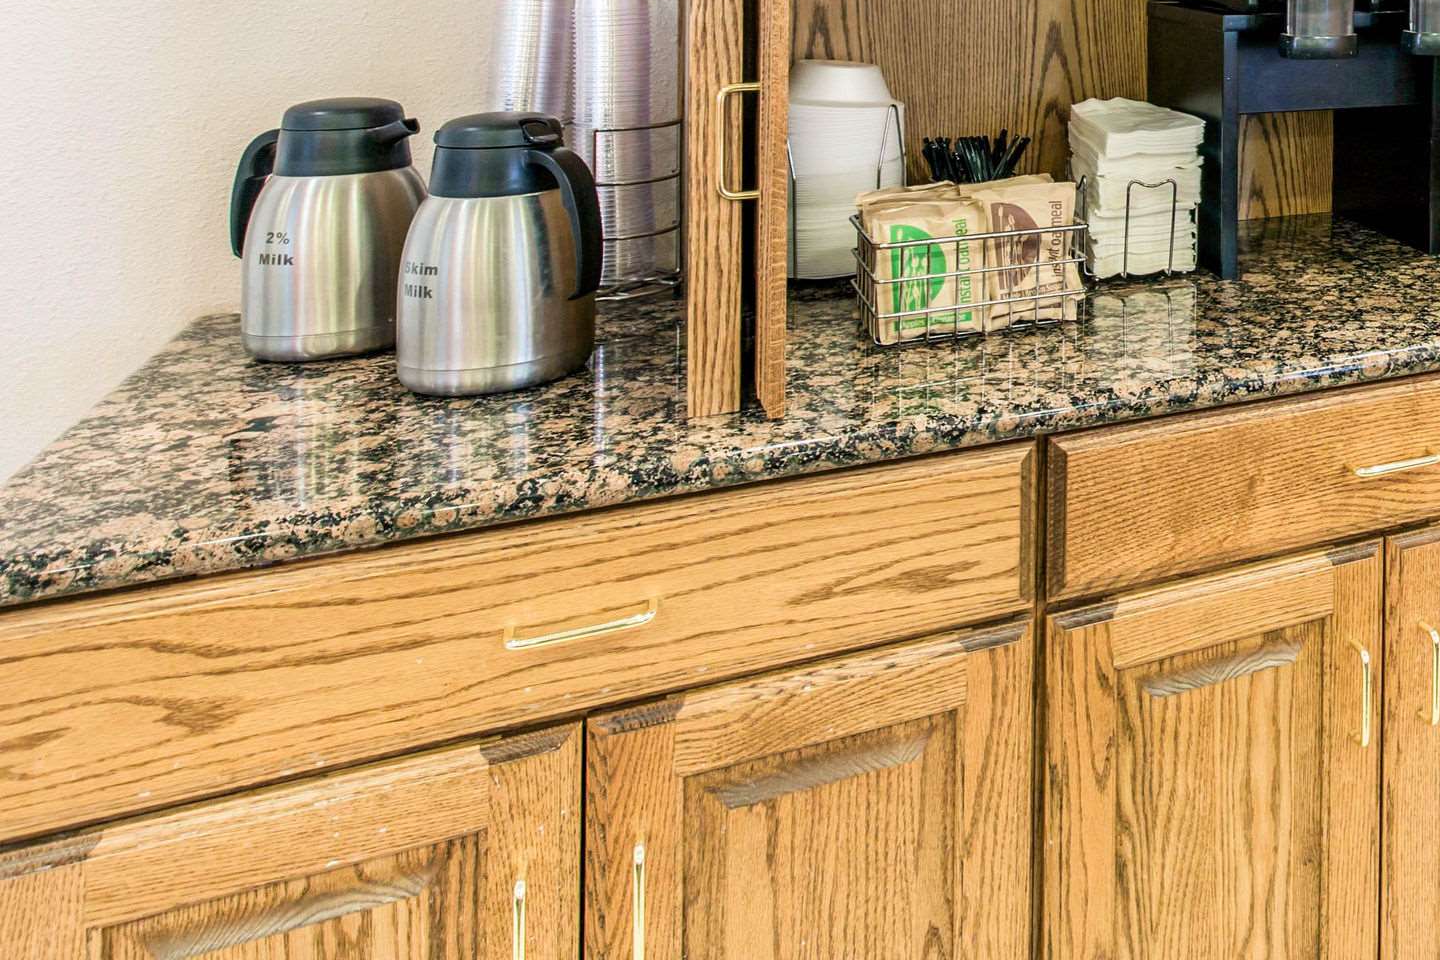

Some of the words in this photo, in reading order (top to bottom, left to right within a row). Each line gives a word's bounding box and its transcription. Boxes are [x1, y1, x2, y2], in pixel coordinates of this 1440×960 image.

[1048, 200, 1063, 246] oameal
[265, 231, 290, 246] 2%
[258, 253, 295, 266] Milk
[404, 261, 438, 276] Skim
[404, 284, 433, 299] Milk
